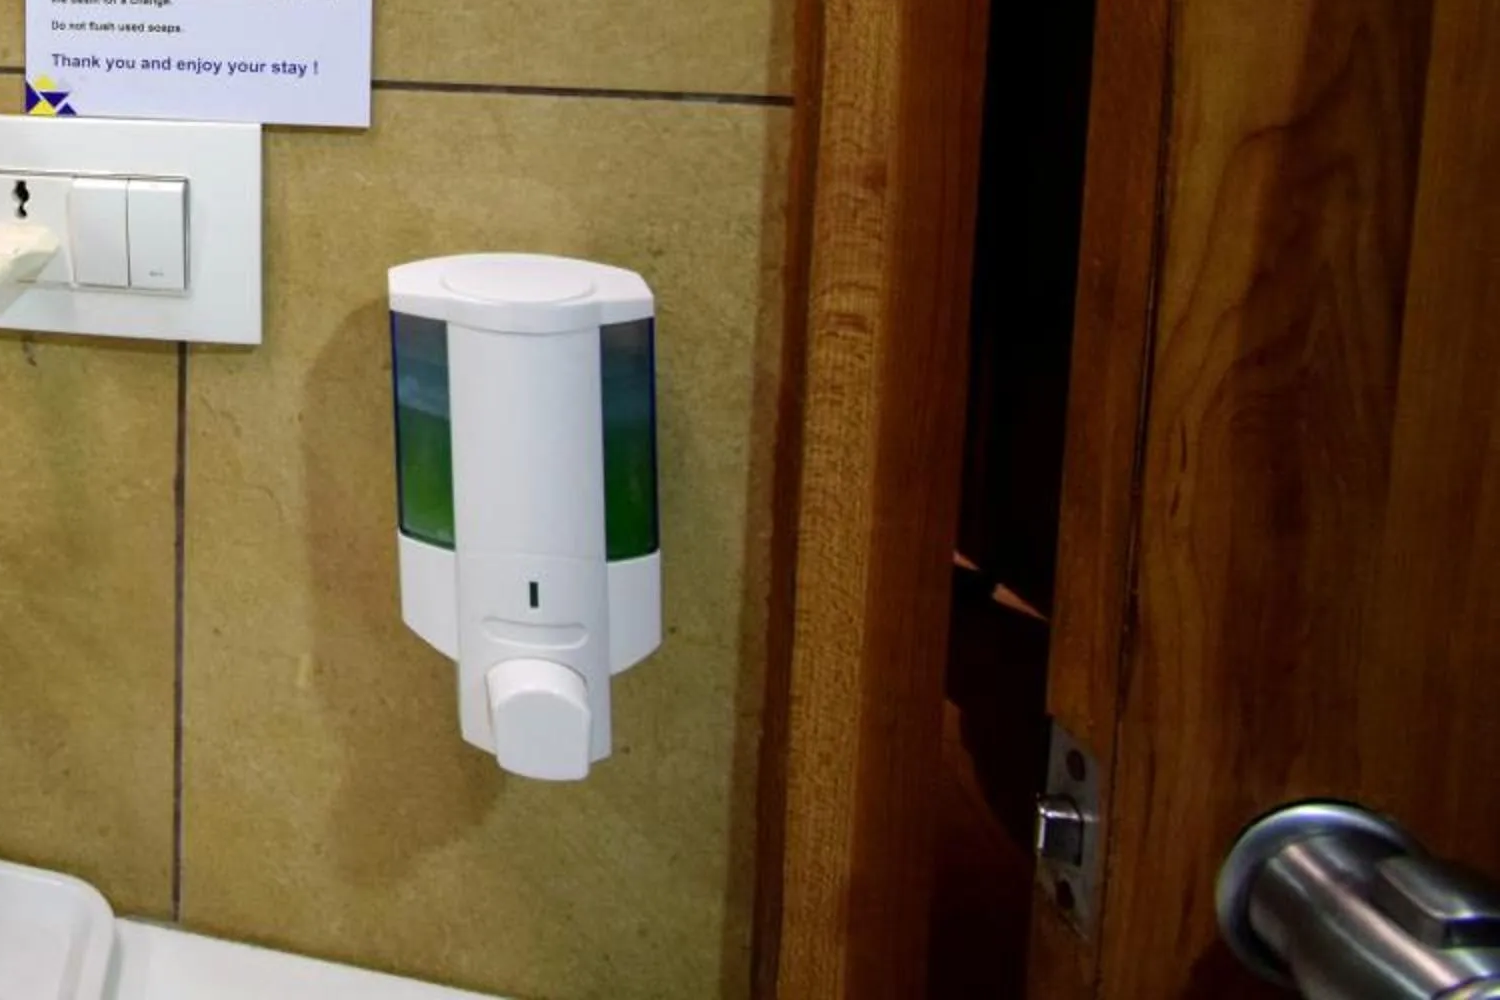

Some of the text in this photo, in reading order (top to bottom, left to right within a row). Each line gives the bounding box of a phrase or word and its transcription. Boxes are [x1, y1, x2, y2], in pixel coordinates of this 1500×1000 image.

[52, 20, 66, 31] Do
[68, 20, 86, 31] not
[88, 21, 116, 32] flush
[118, 21, 144, 32] used
[52, 53, 100, 68] Thank
[106, 58, 136, 74] you
[140, 56, 172, 71] and
[176, 57, 222, 76] enjoy
[228, 62, 266, 77] your
[272, 60, 308, 79] stay
